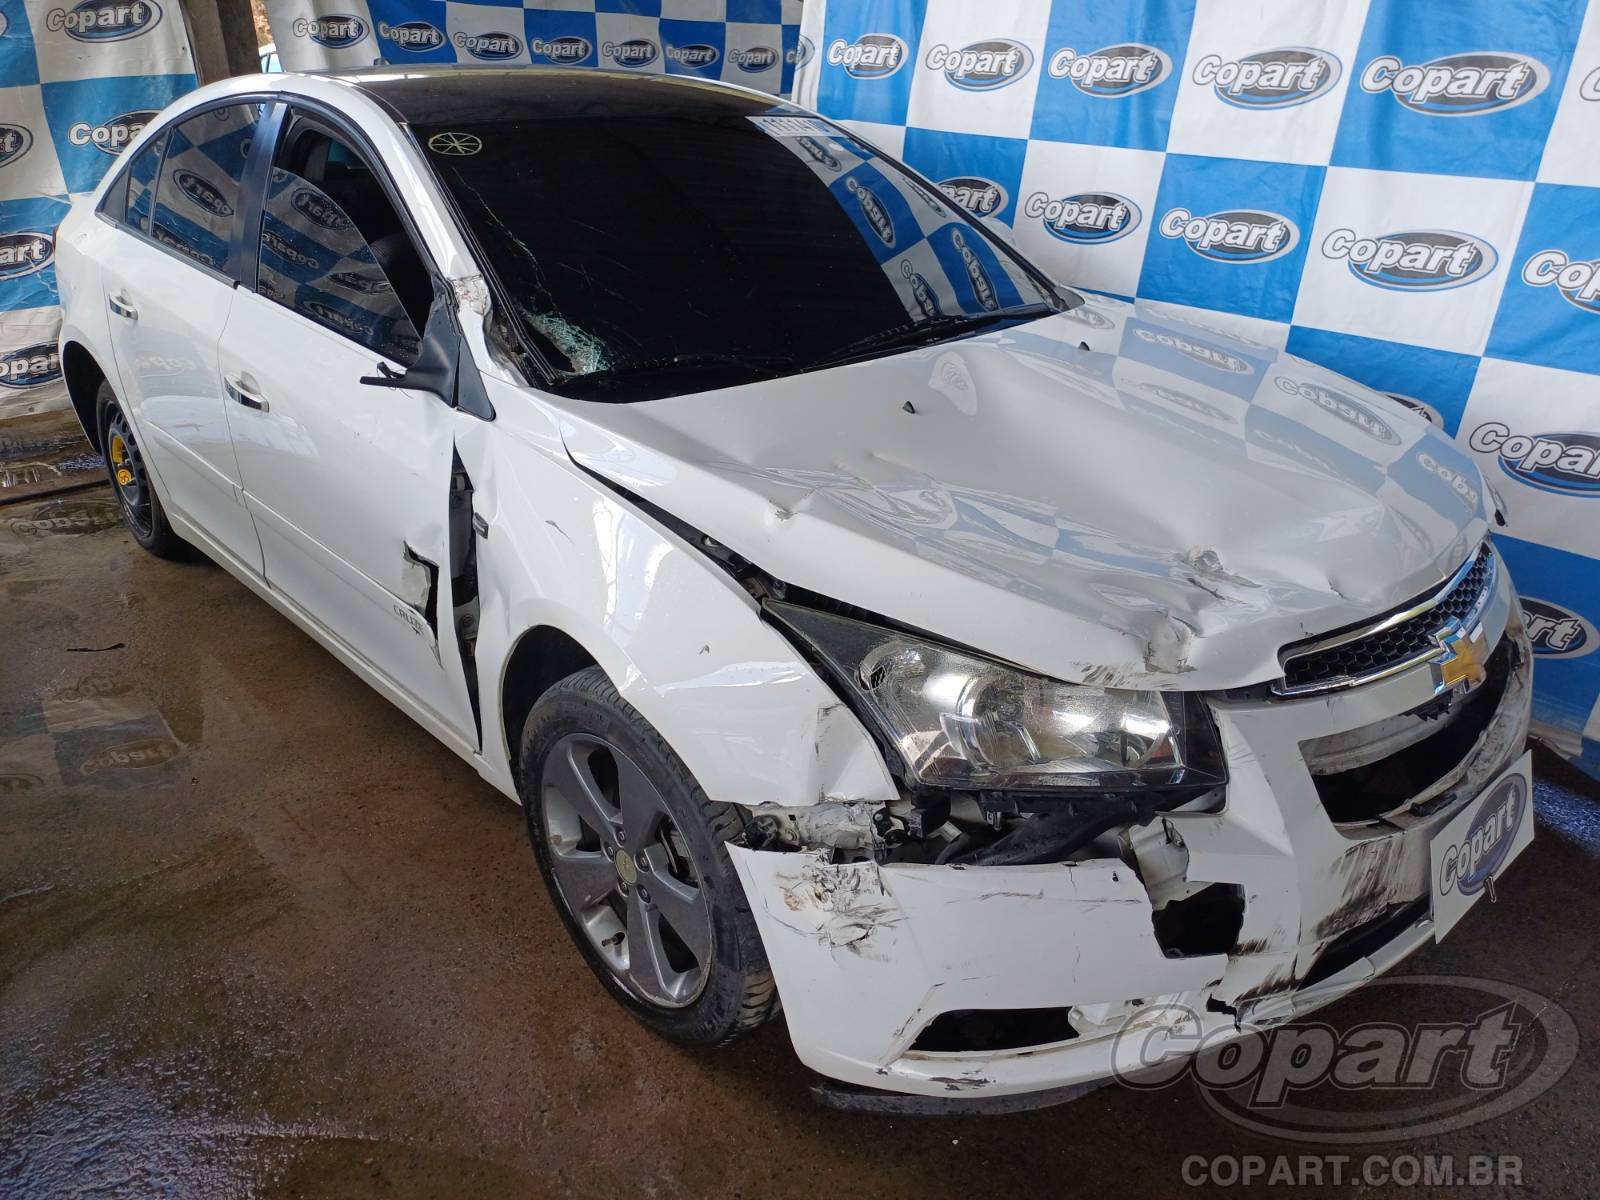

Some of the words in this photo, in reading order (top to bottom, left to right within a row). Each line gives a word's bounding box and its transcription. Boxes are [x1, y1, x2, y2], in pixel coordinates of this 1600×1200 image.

[47, 1, 144, 33] Copart
[293, 18, 360, 39] Copart
[378, 21, 440, 45] Copart
[453, 32, 517, 54] Copart
[531, 39, 587, 60] Copart
[602, 40, 653, 60] Copart
[665, 44, 713, 62] Copart
[728, 49, 773, 66] Copart
[828, 38, 902, 72] Copart
[925, 44, 1021, 78] Copart
[1048, 47, 1163, 87] Copart
[1192, 54, 1329, 94] Copart
[1361, 56, 1530, 104] Copart
[69, 121, 146, 148] Copa
[1024, 191, 1126, 232] Copart
[1159, 207, 1289, 251] Copart
[0, 238, 46, 264] art
[1322, 228, 1476, 275] Copart
[1469, 422, 1600, 479] Copa
[1440, 783, 1516, 896] Copart
